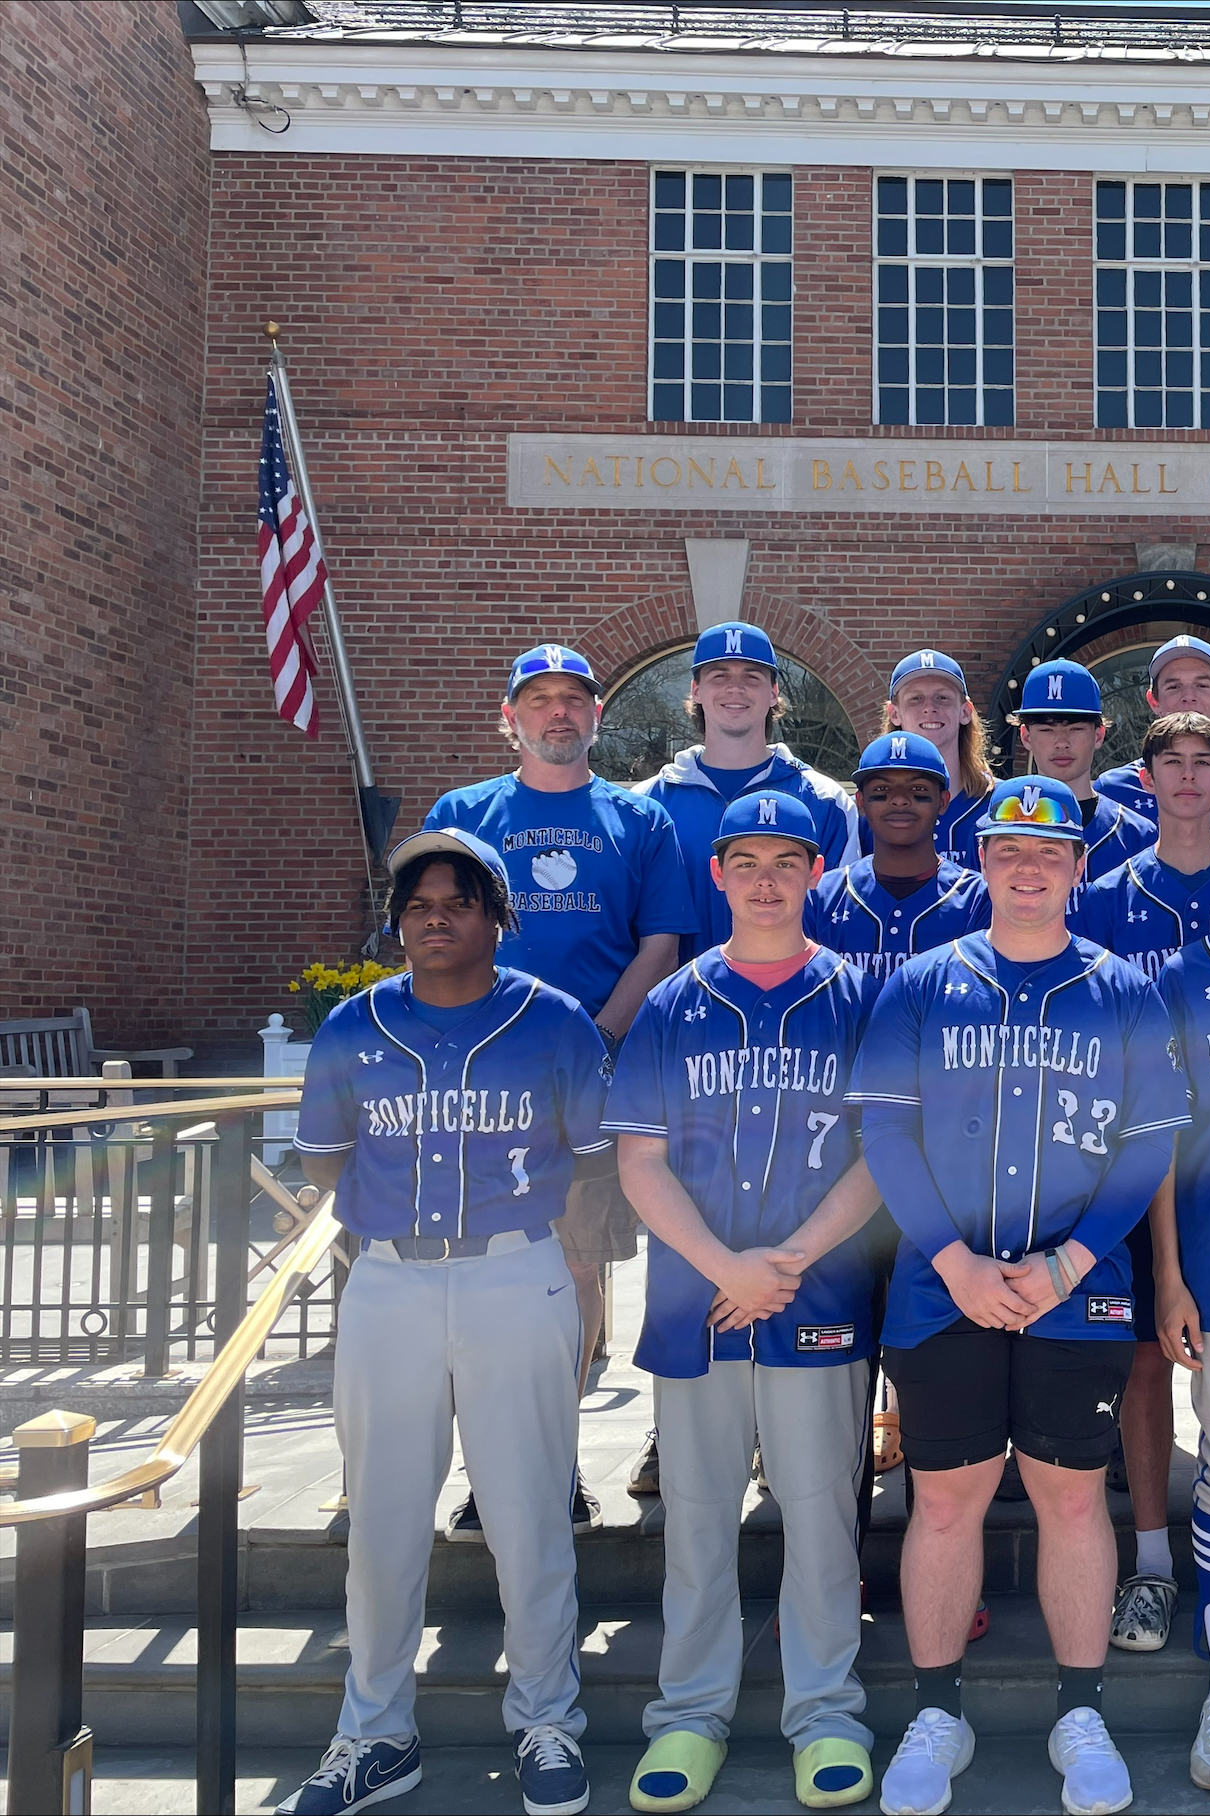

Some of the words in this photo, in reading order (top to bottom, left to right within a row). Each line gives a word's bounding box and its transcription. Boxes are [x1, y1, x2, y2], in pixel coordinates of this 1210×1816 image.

[543, 455, 777, 489] NATIONAL
[811, 458, 1034, 492] BASEBALL
[1064, 461, 1179, 494] HALL
[725, 629, 743, 654] M
[920, 653, 935, 668] M
[1047, 674, 1064, 700] M
[890, 736, 907, 760] M
[757, 798, 778, 825] M
[503, 827, 603, 854] MONTICELLO
[942, 1023, 1101, 1079] MONTICELLO
[685, 1046, 838, 1101] MONTICELLO
[363, 1088, 534, 1137] MONTICELLO
[1052, 1088, 1117, 1155] 23
[806, 1110, 840, 1170] 7
